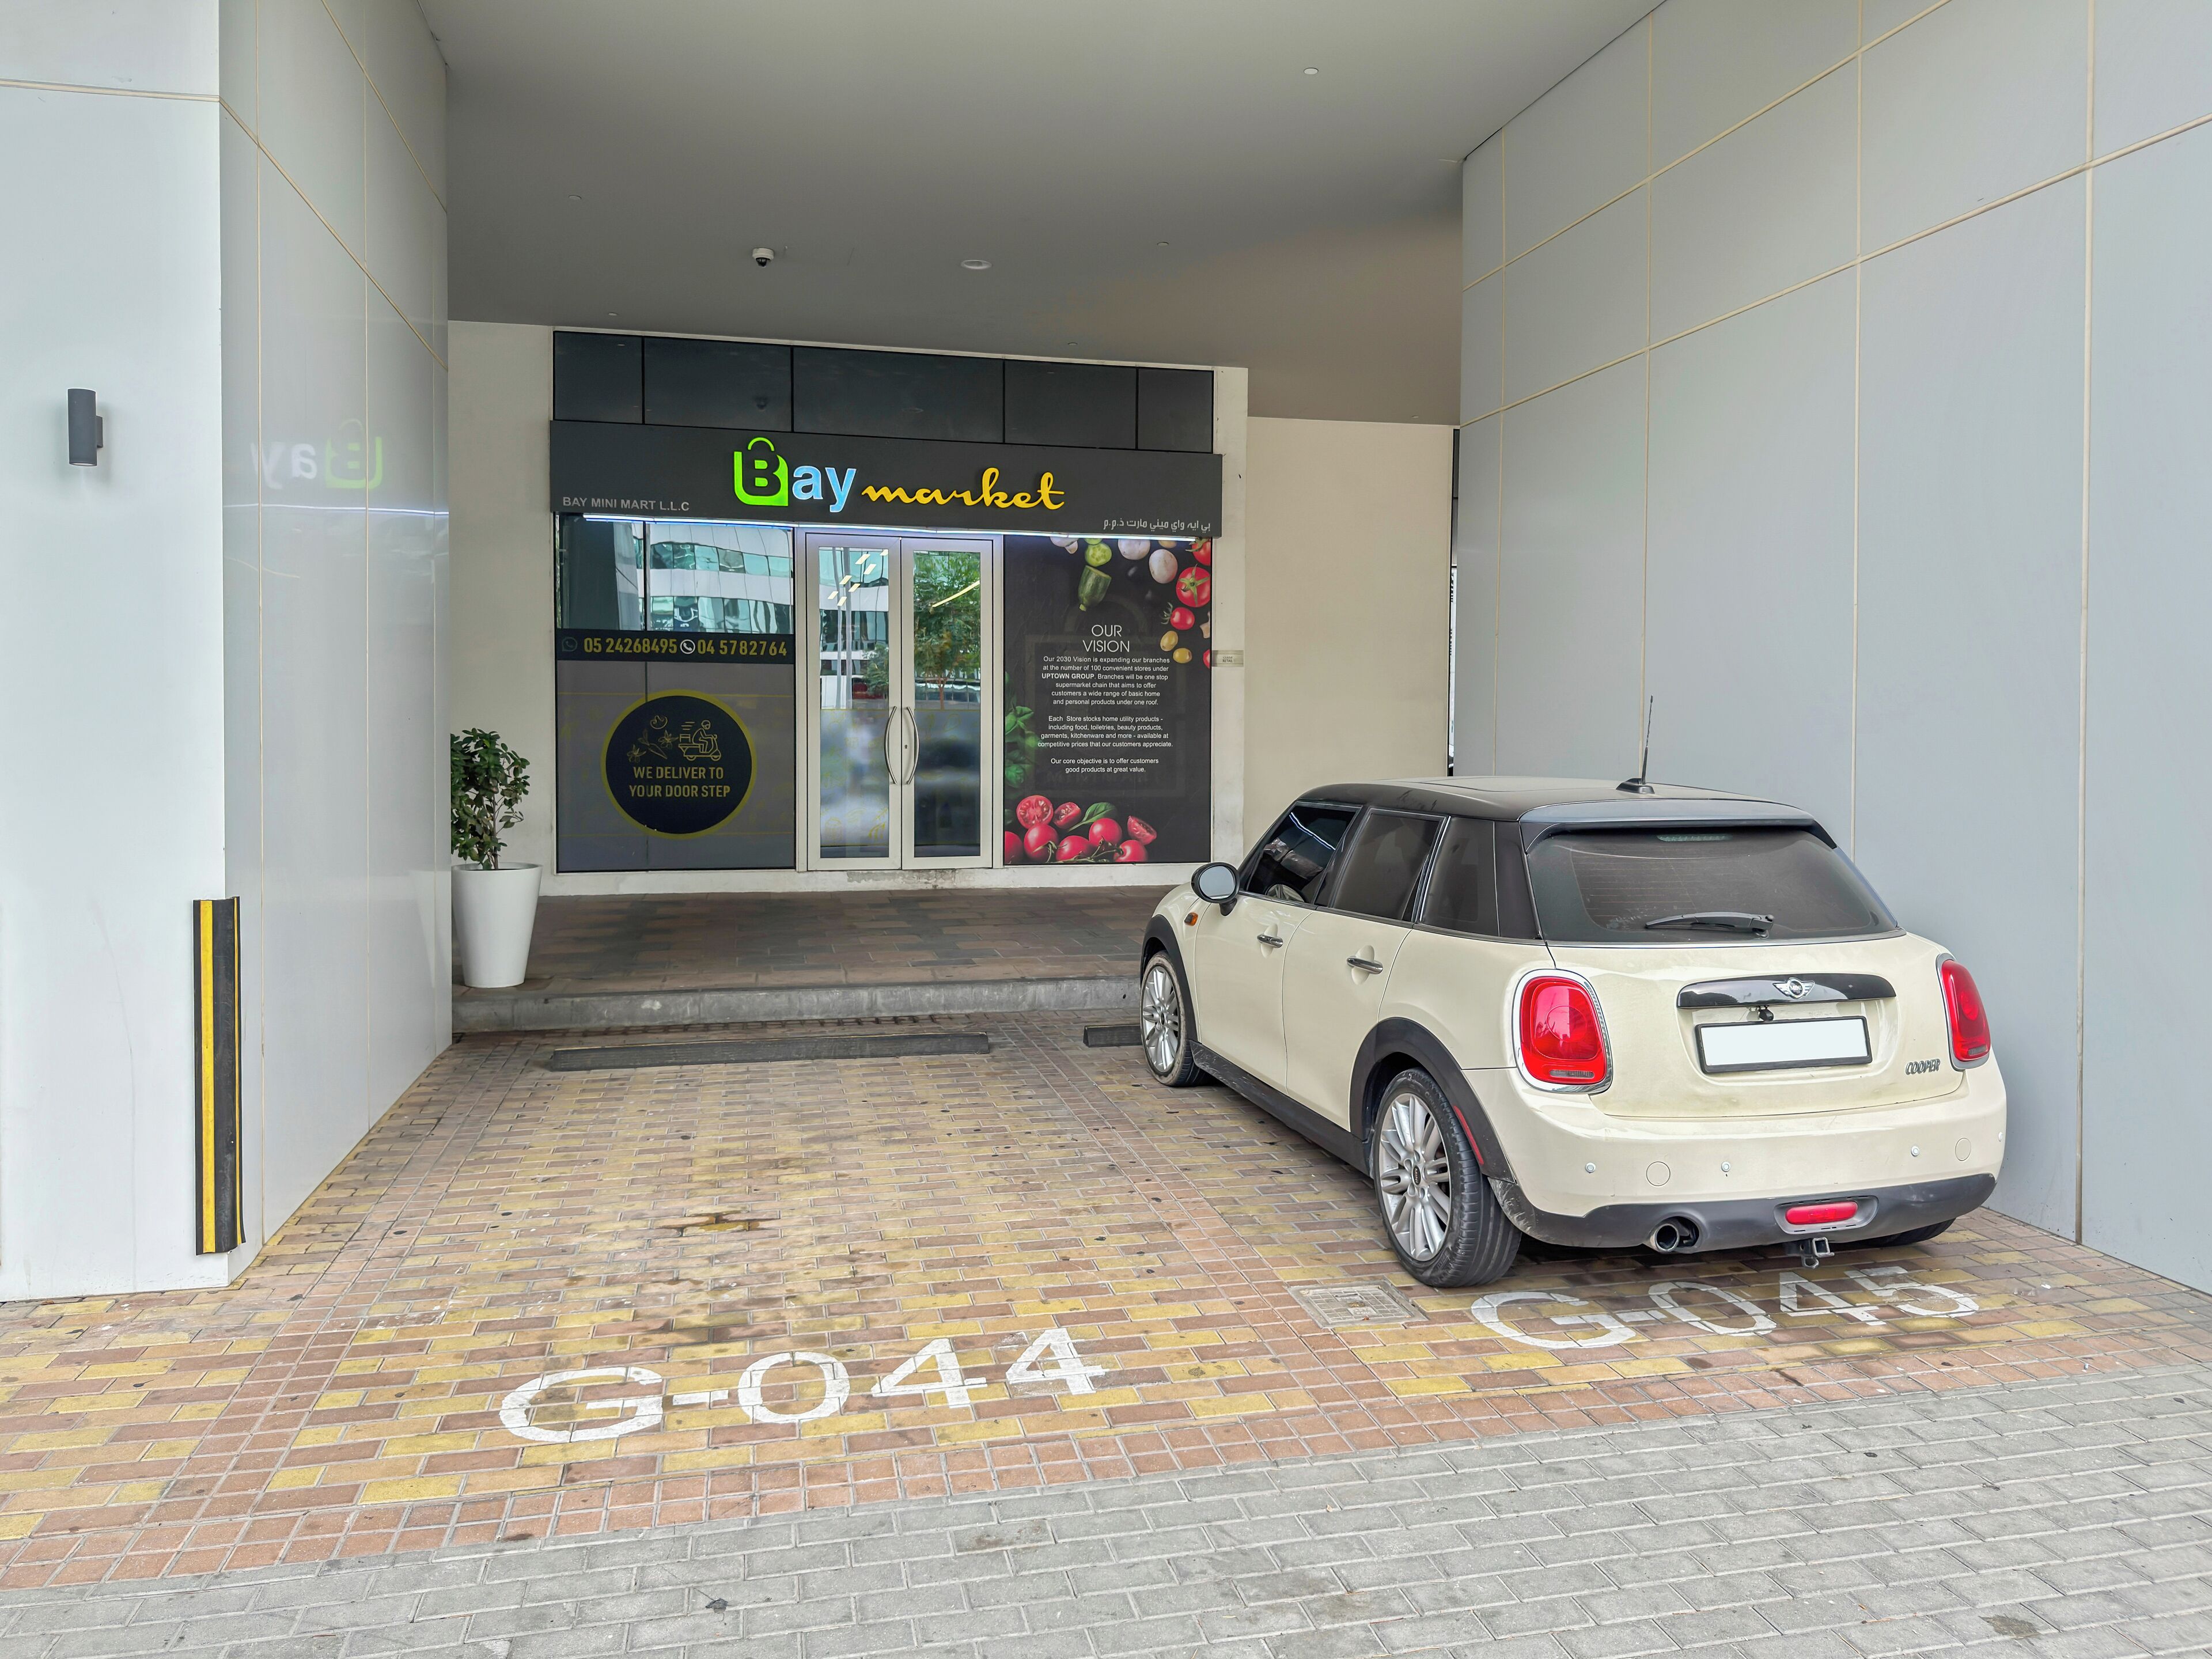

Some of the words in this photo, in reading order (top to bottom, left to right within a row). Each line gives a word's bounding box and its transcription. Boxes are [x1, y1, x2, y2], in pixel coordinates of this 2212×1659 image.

[734, 437, 857, 513] Bay
[862, 468, 1065, 510] market
[563, 497, 588, 506] BAY
[591, 498, 617, 508] MINI
[621, 499, 656, 510] MART
[660, 501, 690, 512] L.L.C
[1126, 518, 1147, 528] مارت
[1150, 519, 1169, 532] ميني
[1171, 520, 1184, 532] واي
[1200, 522, 1211, 533] بي
[1091, 624, 1122, 637] OUR
[584, 637, 602, 653] 05
[605, 638, 677, 654] 24268495
[697, 639, 715, 655] 04
[719, 640, 787, 656] 5782764
[1082, 639, 1130, 653] VISION
[1048, 724, 1074, 732] including
[1037, 740, 1070, 748] competitive
[633, 767, 653, 779] WE
[656, 767, 706, 779] DELIVER
[709, 767, 724, 779] TO
[629, 785, 662, 797] YOUR
[665, 785, 698, 797] DOOR
[701, 785, 730, 797] STEP
[1905, 1058, 1941, 1075] COOPER
[1471, 1266, 1980, 1348] G-045
[499, 1327, 1110, 1442] G-044
